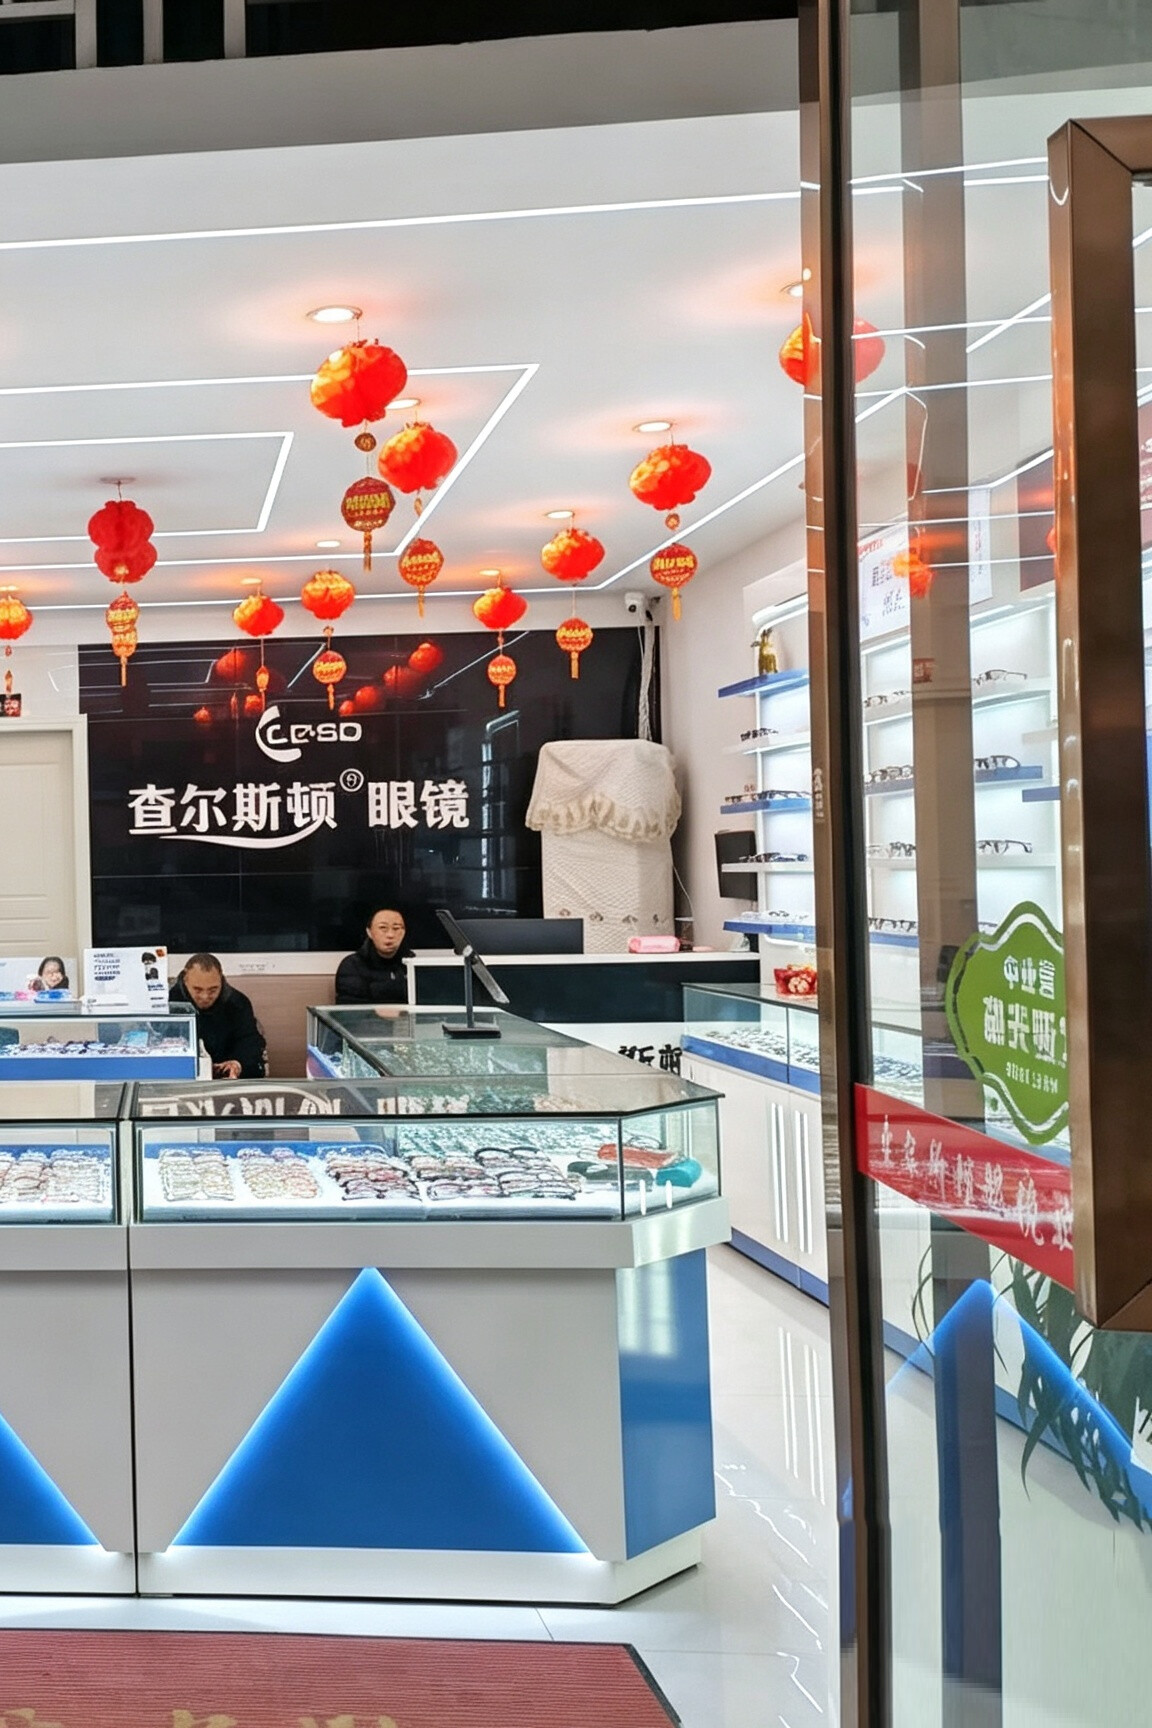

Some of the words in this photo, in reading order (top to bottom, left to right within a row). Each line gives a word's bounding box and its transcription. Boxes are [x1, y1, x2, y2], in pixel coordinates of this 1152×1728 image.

[127, 781, 338, 836] 查尔斯顿
[367, 779, 470, 830] 眼镜
